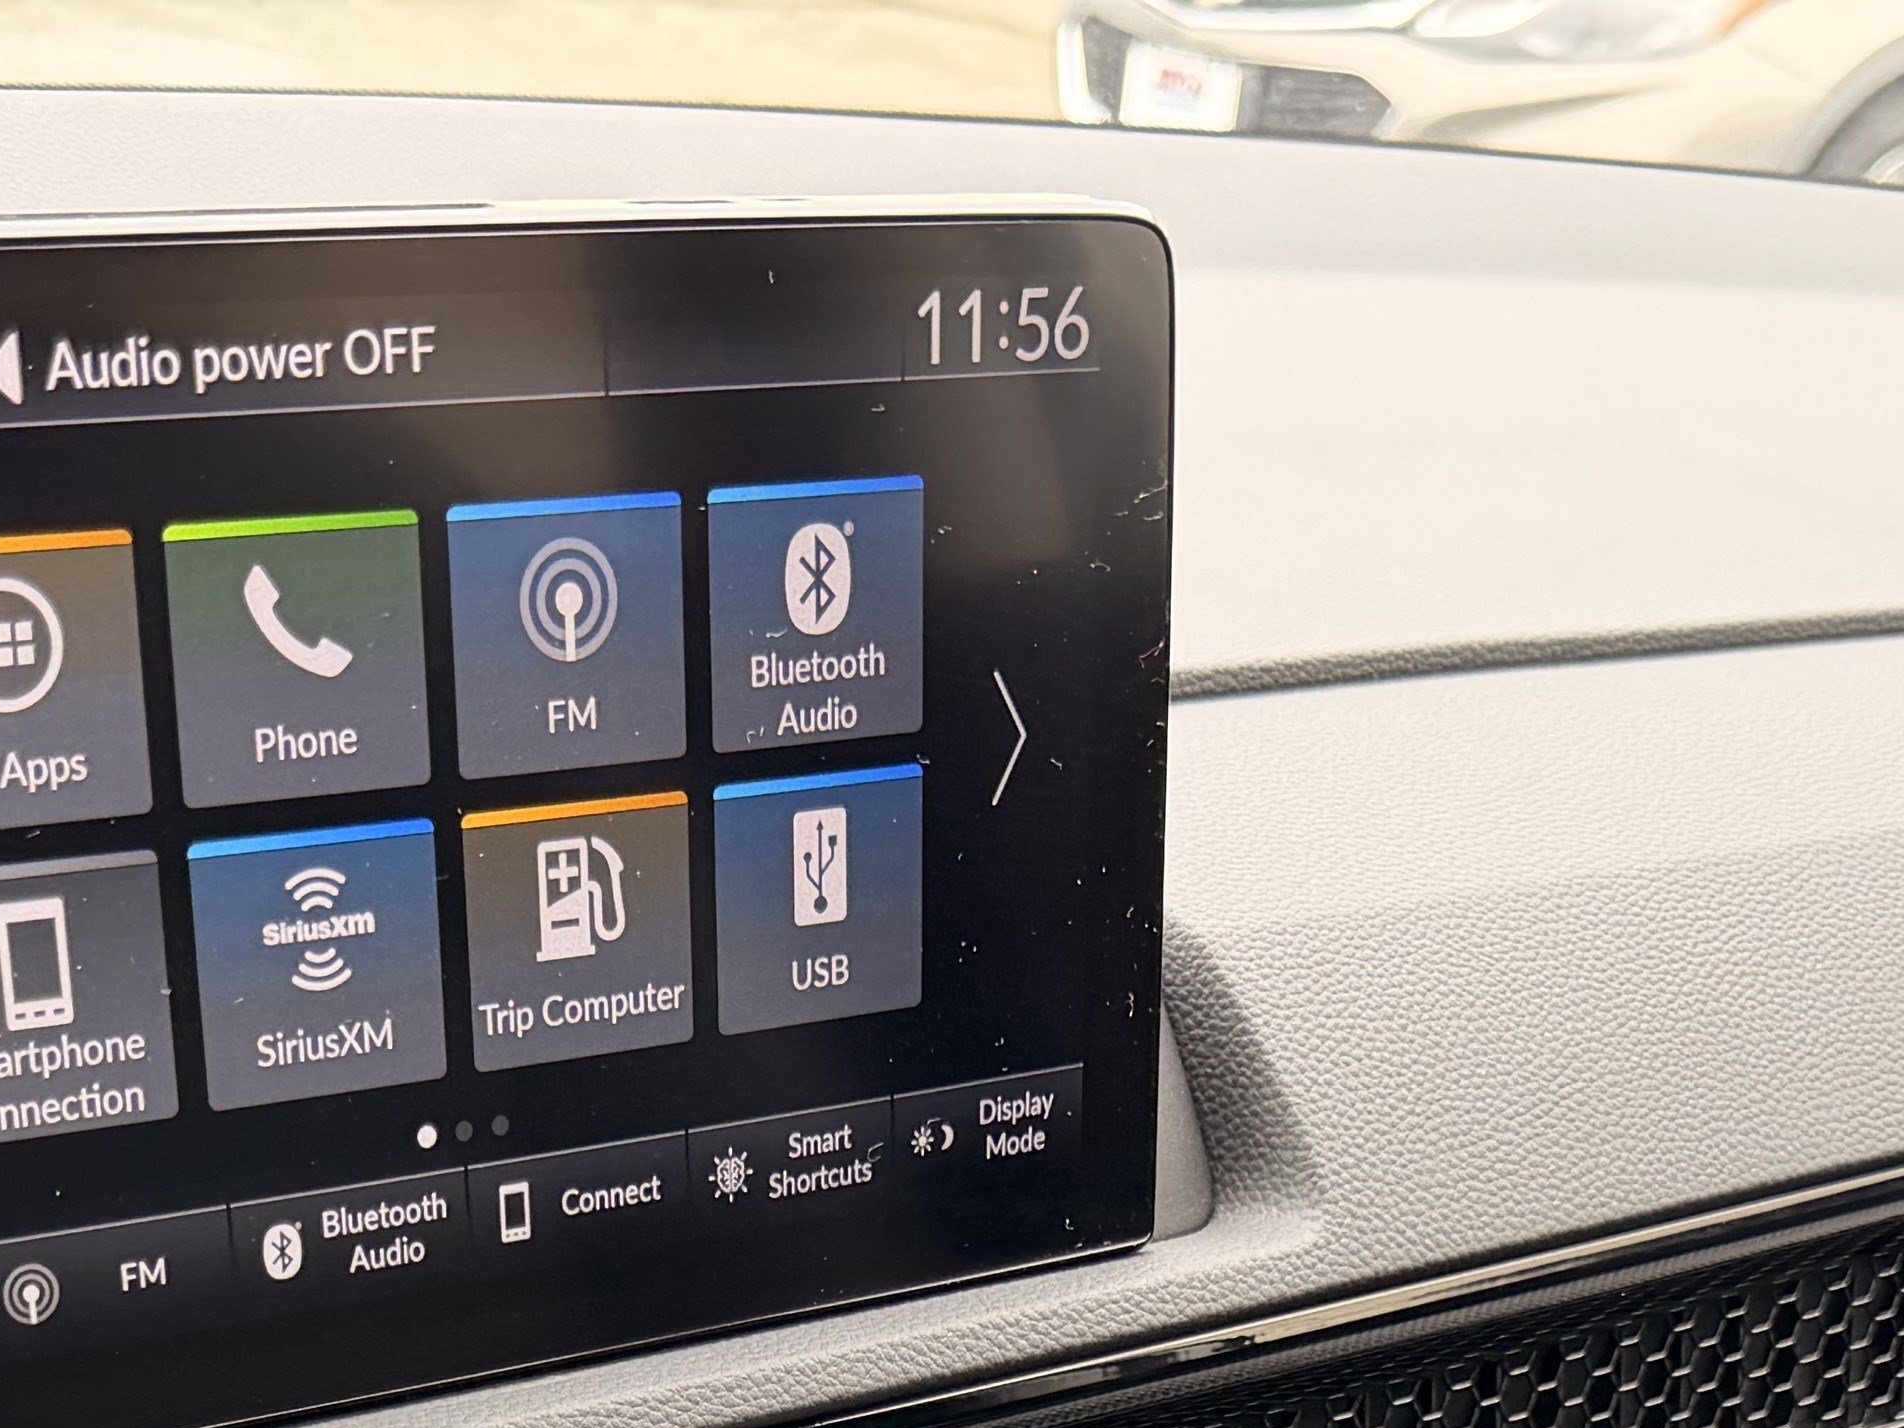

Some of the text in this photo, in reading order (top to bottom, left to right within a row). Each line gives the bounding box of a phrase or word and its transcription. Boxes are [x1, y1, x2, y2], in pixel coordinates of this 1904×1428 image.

[918, 286, 1090, 365] 11:56
[45, 325, 437, 394] Audio power OFF
[749, 644, 886, 690] Bluetooth
[547, 697, 598, 735] FM
[777, 702, 858, 736] Audio
[254, 724, 358, 763] Phone
[0, 751, 89, 794] Apps
[791, 954, 850, 992] USB
[478, 981, 685, 1038] Trip Computer
[257, 1019, 395, 1069] SiriusXM
[978, 1091, 1055, 1129] Display
[787, 1124, 853, 1161] Smart
[985, 1128, 1046, 1161] Mode
[561, 1177, 662, 1217] Connect
[768, 1157, 873, 1200] Shortcuts
[321, 1194, 448, 1239] Bluetooth
[120, 1258, 167, 1292] FM
[348, 1238, 426, 1275] Audio
